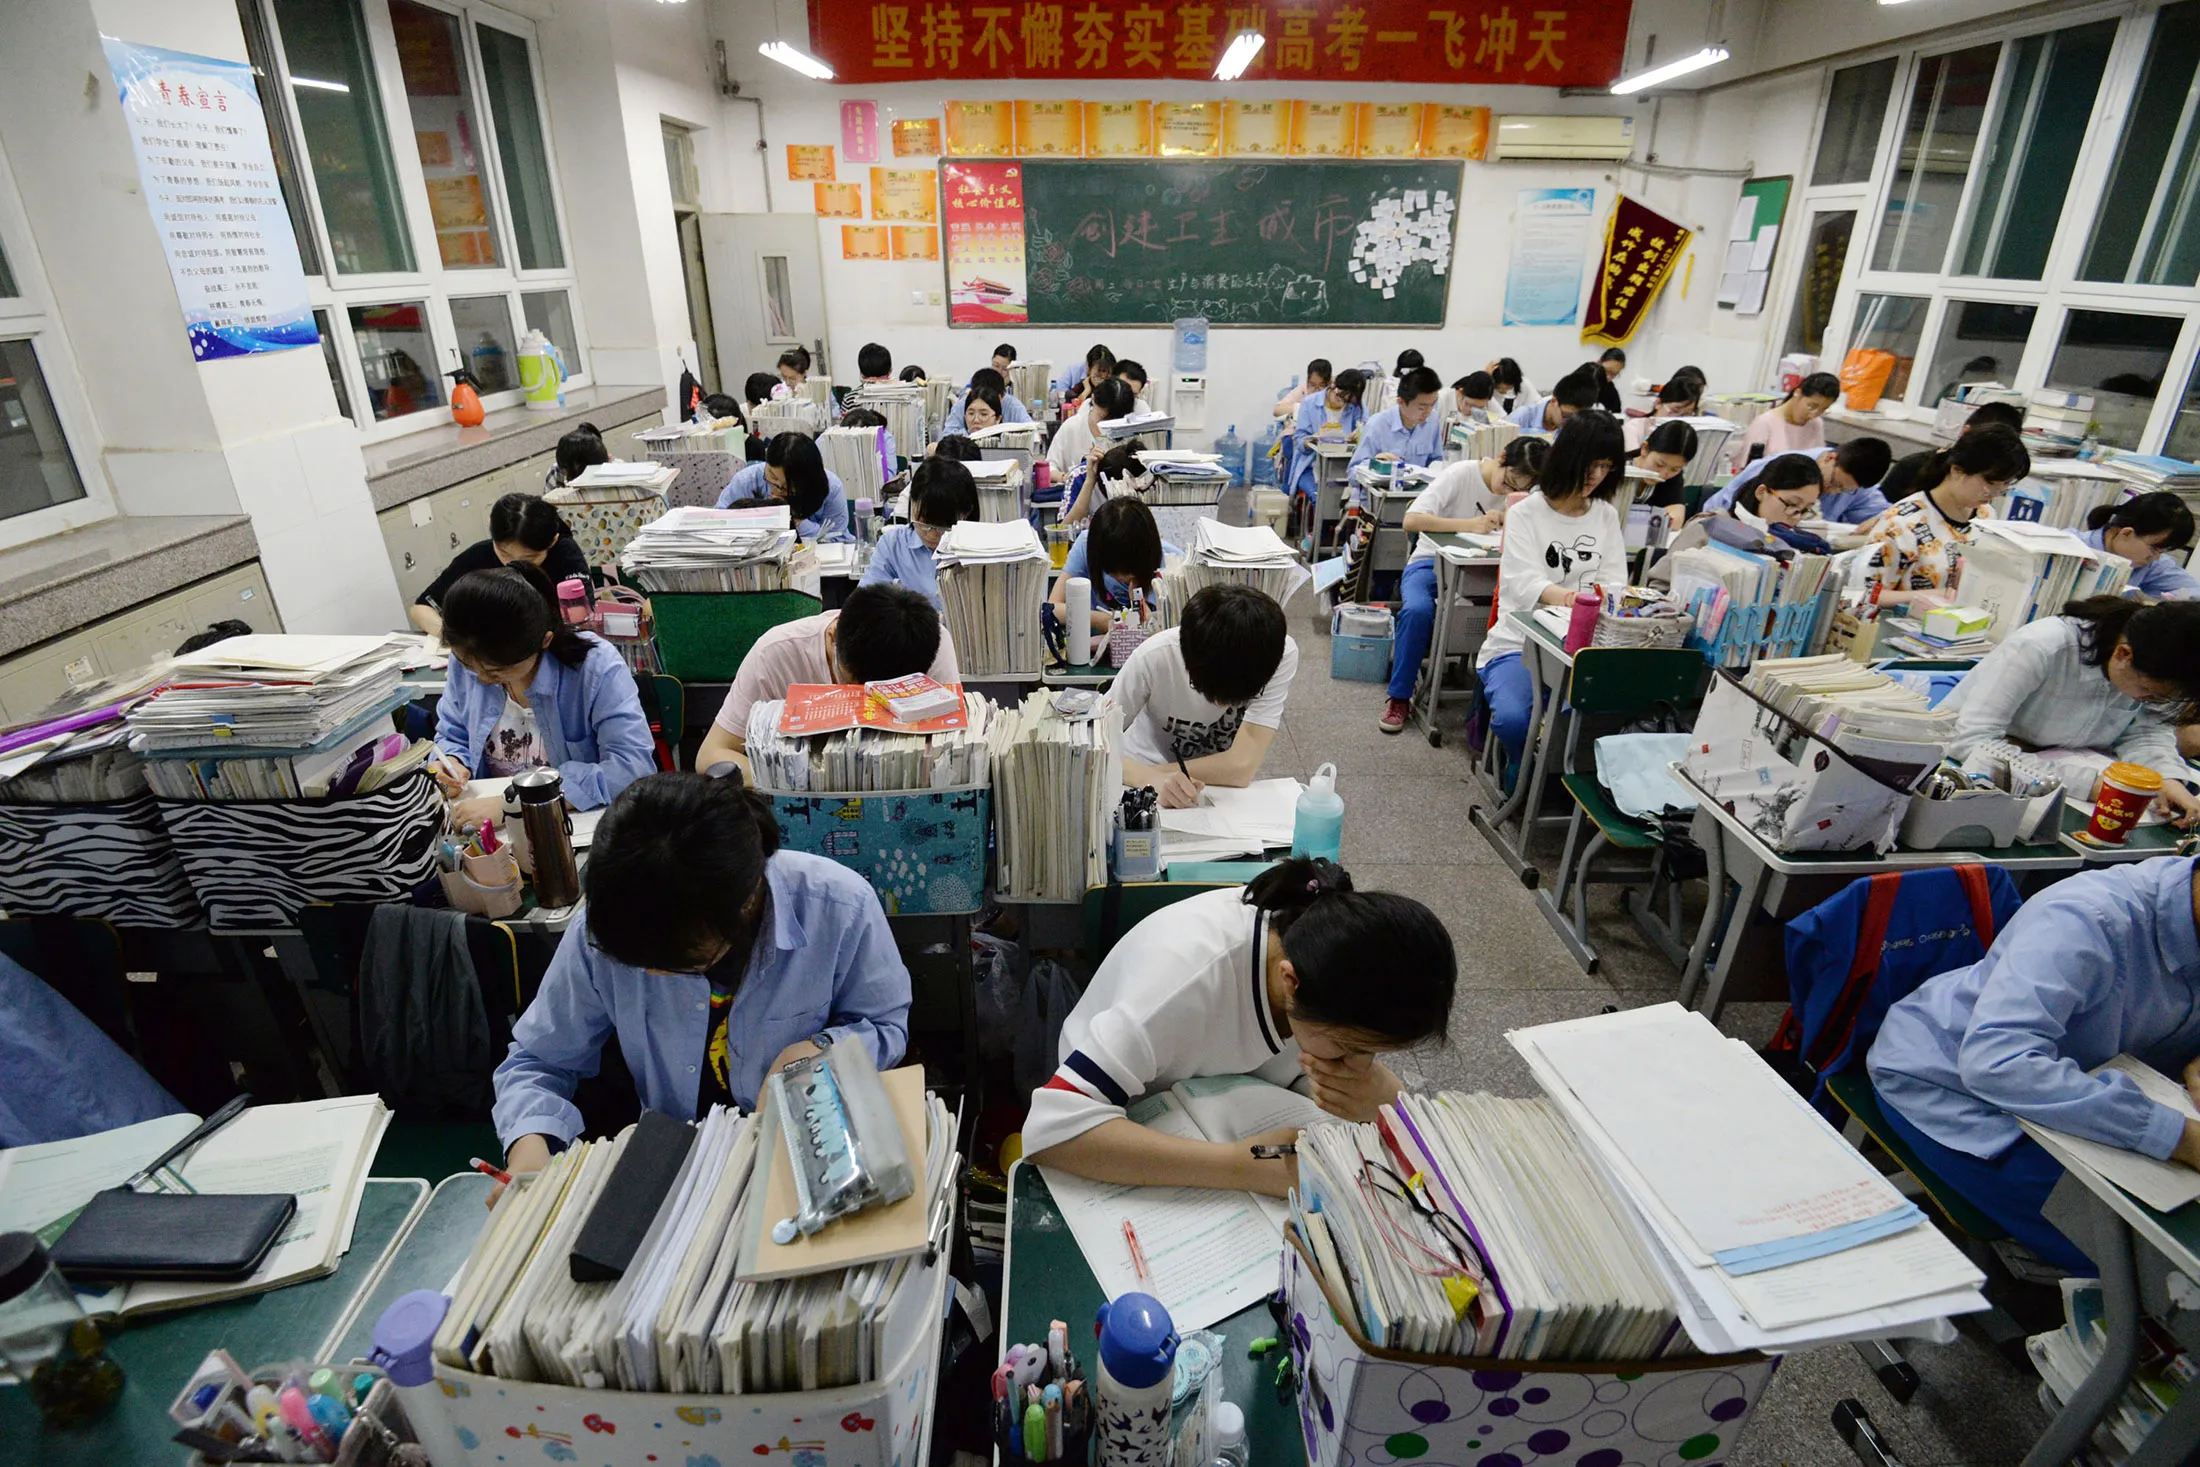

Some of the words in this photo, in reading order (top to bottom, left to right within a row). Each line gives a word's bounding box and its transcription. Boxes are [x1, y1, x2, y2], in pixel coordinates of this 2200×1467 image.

[872, 3, 1567, 72] 坚持不懈夯实基础高考一飞冲天
[156, 79, 228, 113] 青春宣言
[957, 183, 1013, 196] 社会主义
[951, 196, 1021, 209] 核心价值观
